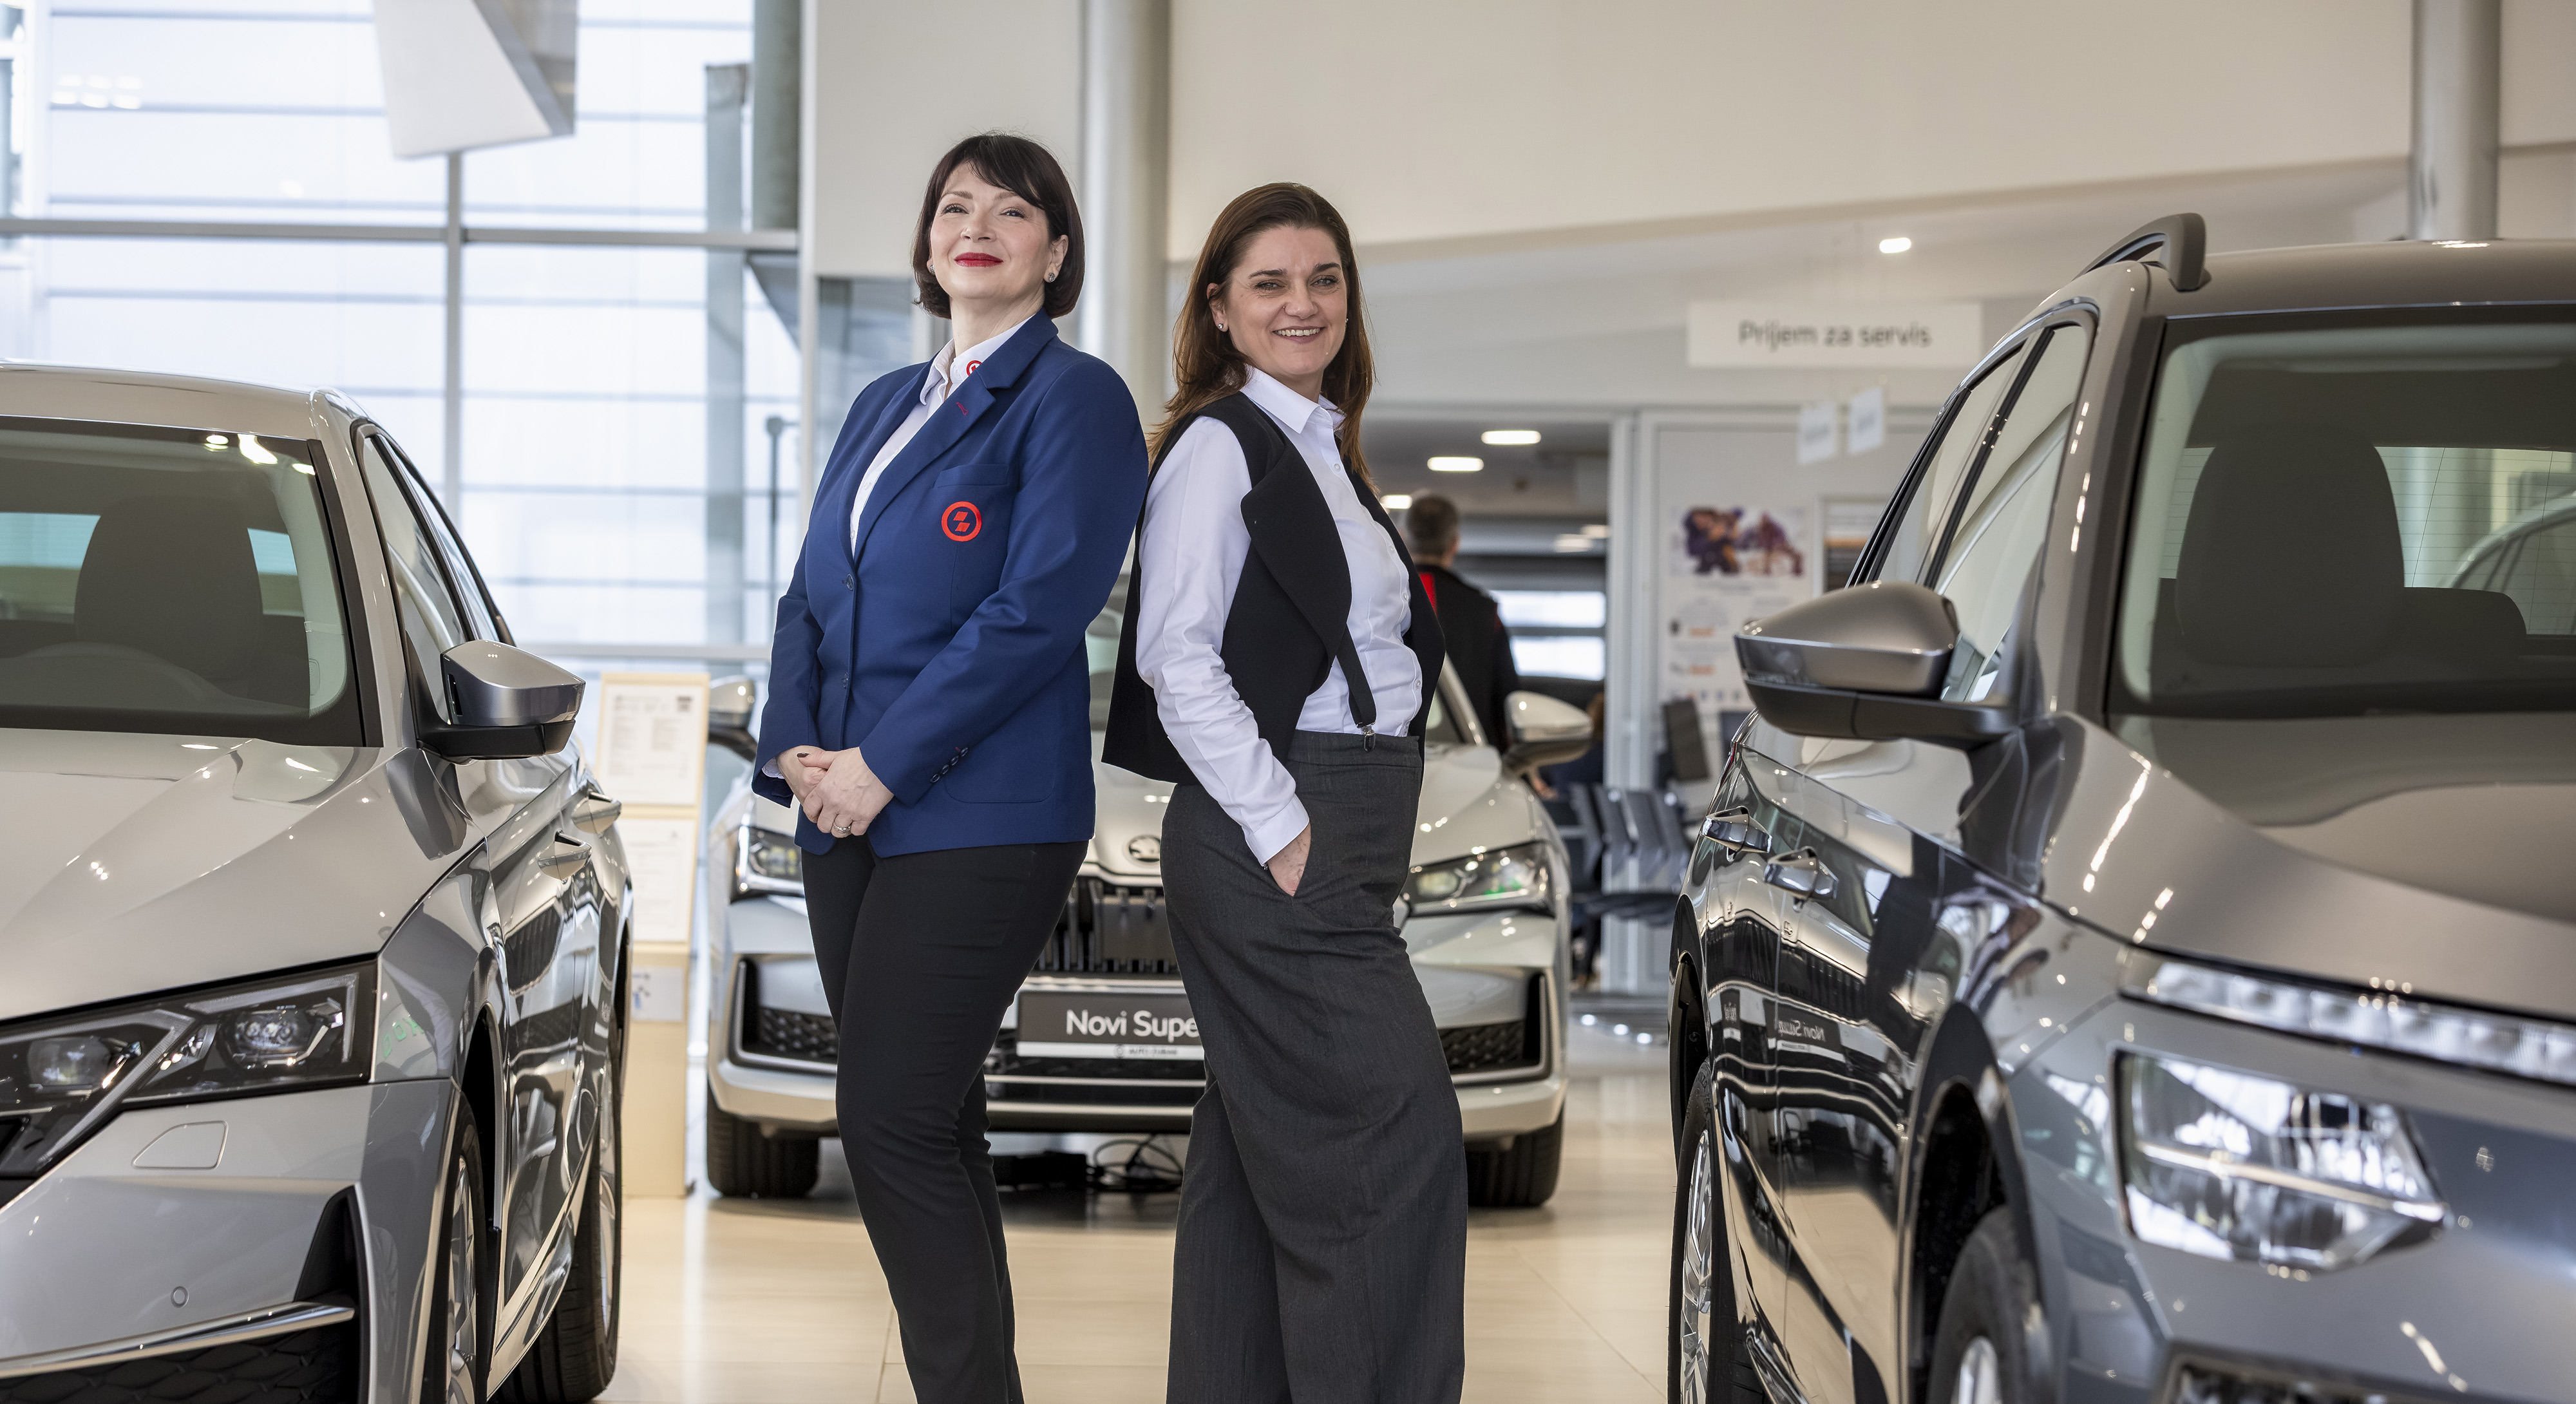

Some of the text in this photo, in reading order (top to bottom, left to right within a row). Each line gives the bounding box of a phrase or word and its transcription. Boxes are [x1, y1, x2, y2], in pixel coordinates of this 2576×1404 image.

[1739, 319, 1931, 352] Prijem za servis
[1066, 1009, 1200, 1043] Novi Supe
